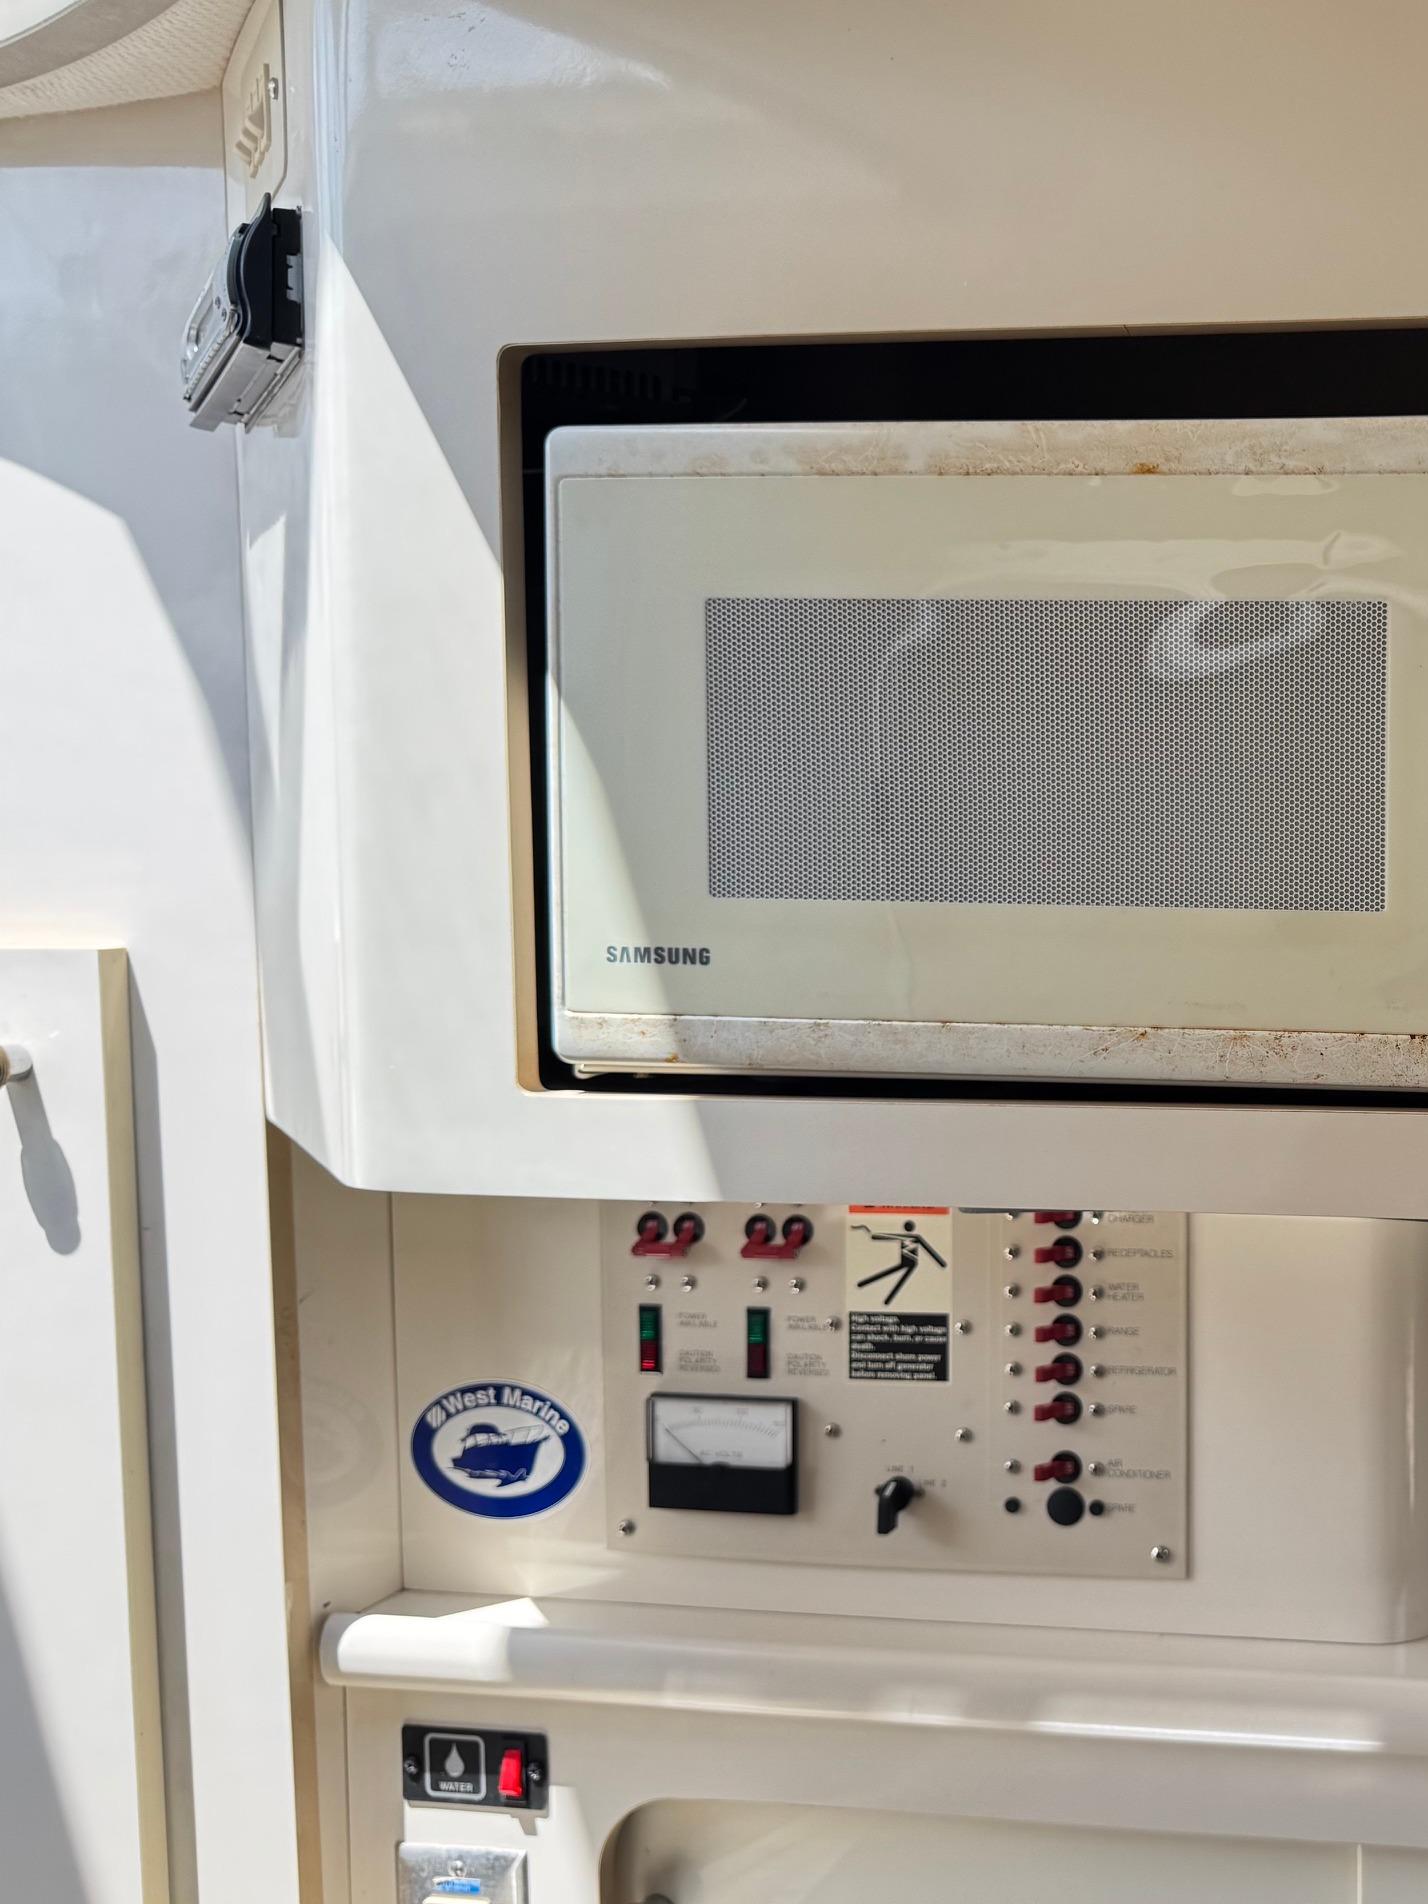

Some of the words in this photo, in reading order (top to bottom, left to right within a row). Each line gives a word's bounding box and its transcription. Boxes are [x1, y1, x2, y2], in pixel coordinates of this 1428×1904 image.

[606, 946, 711, 965] SAMSUNG
[1108, 1282, 1139, 1291] WATER
[901, 1325, 918, 1334] high
[442, 1386, 497, 1414] West
[502, 1386, 570, 1434] Marine
[439, 1781, 473, 1793] WATER
